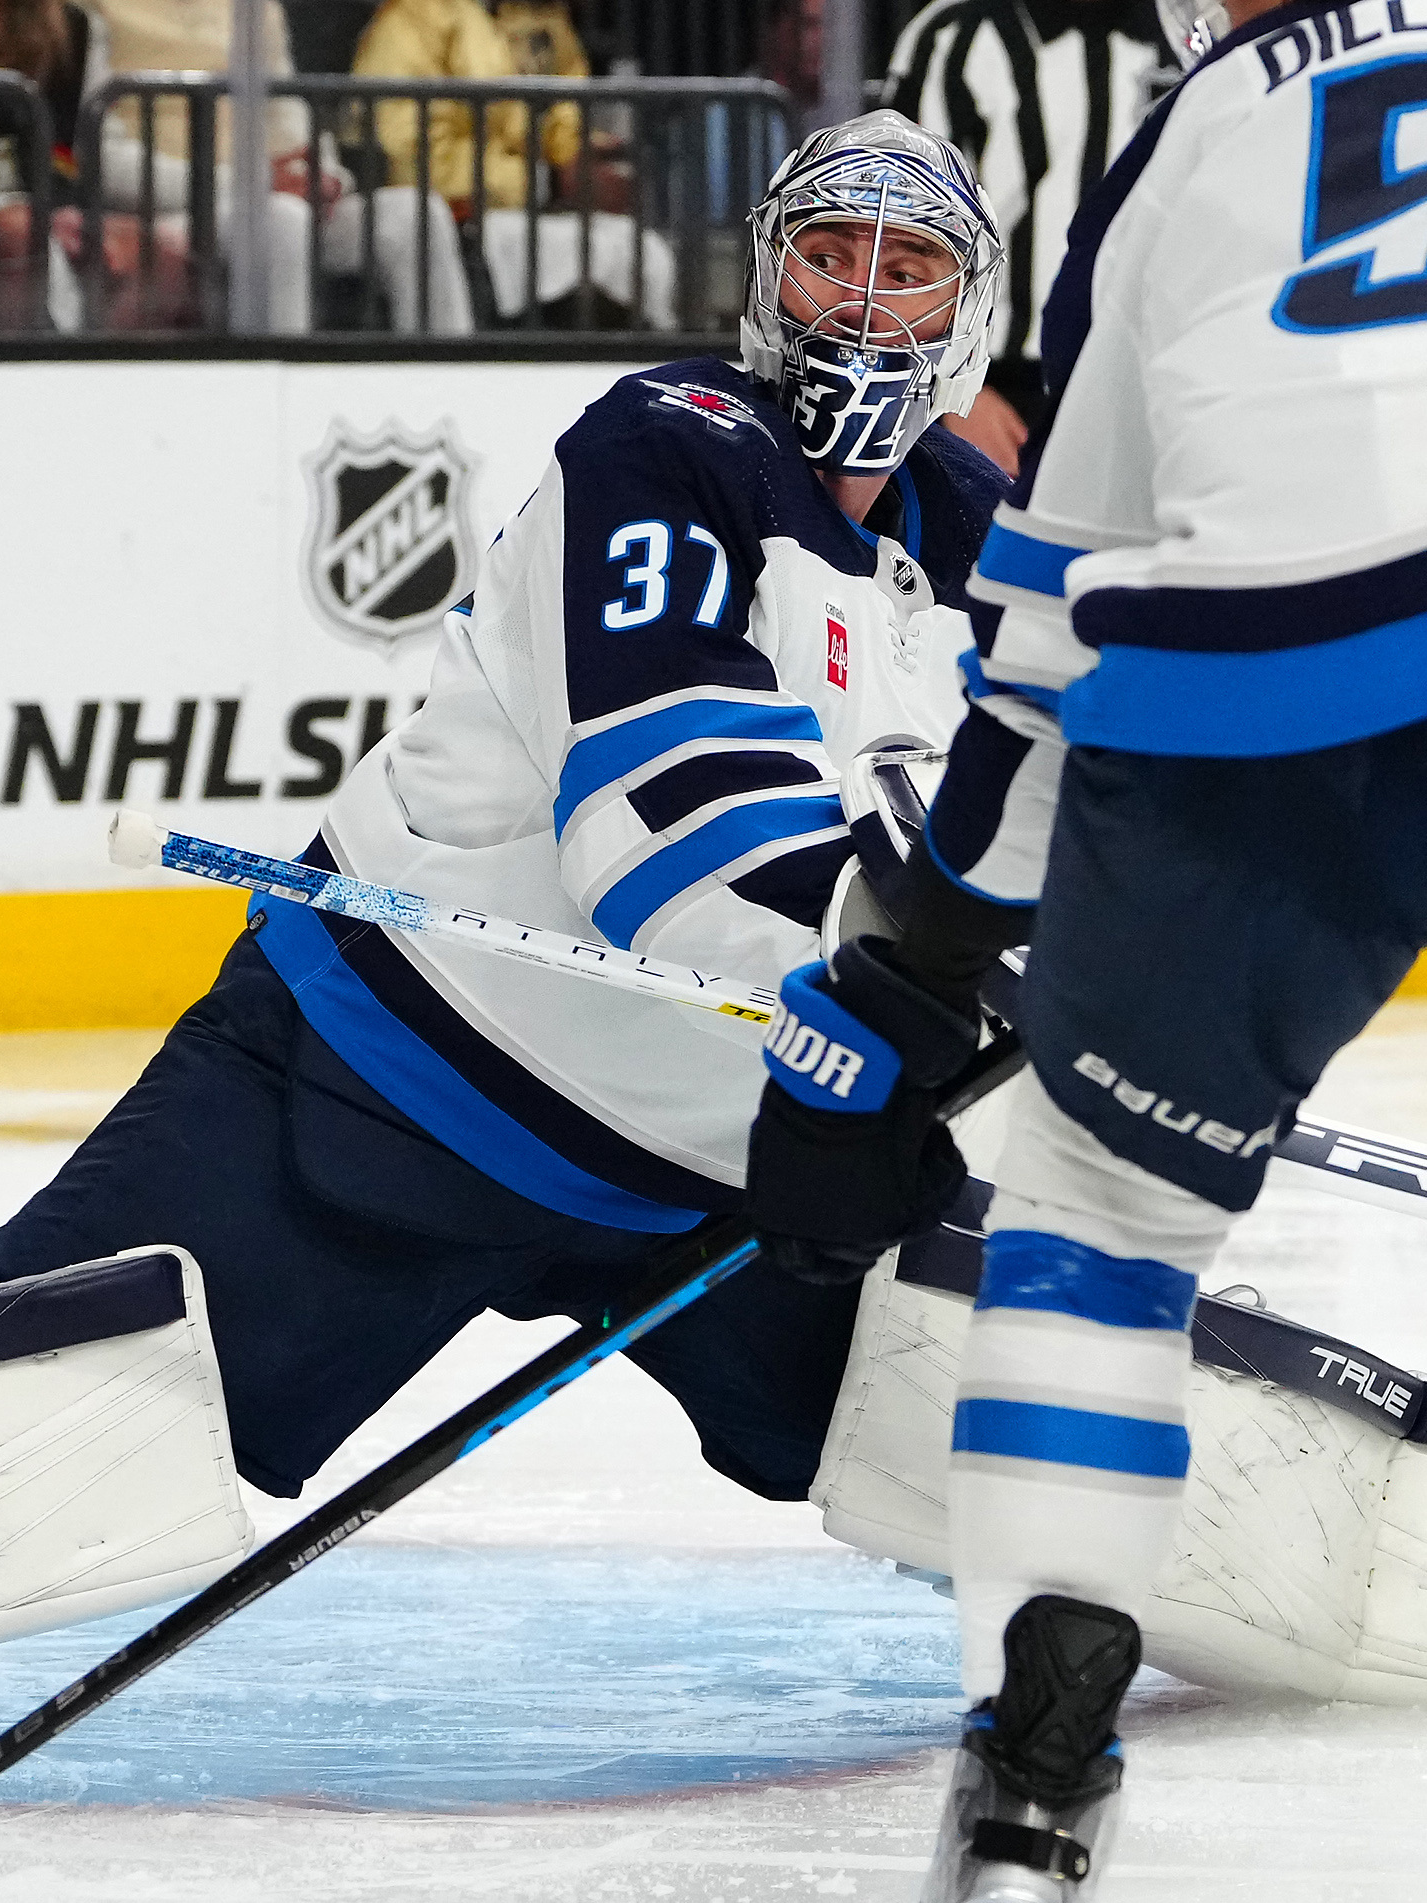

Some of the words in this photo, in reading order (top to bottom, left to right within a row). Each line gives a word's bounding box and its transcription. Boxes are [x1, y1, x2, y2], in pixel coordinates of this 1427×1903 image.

[343, 485, 444, 600] NHL
[600, 518, 732, 632] 37
[827, 633, 848, 681] life
[1309, 1346, 1413, 1419] TRUE
